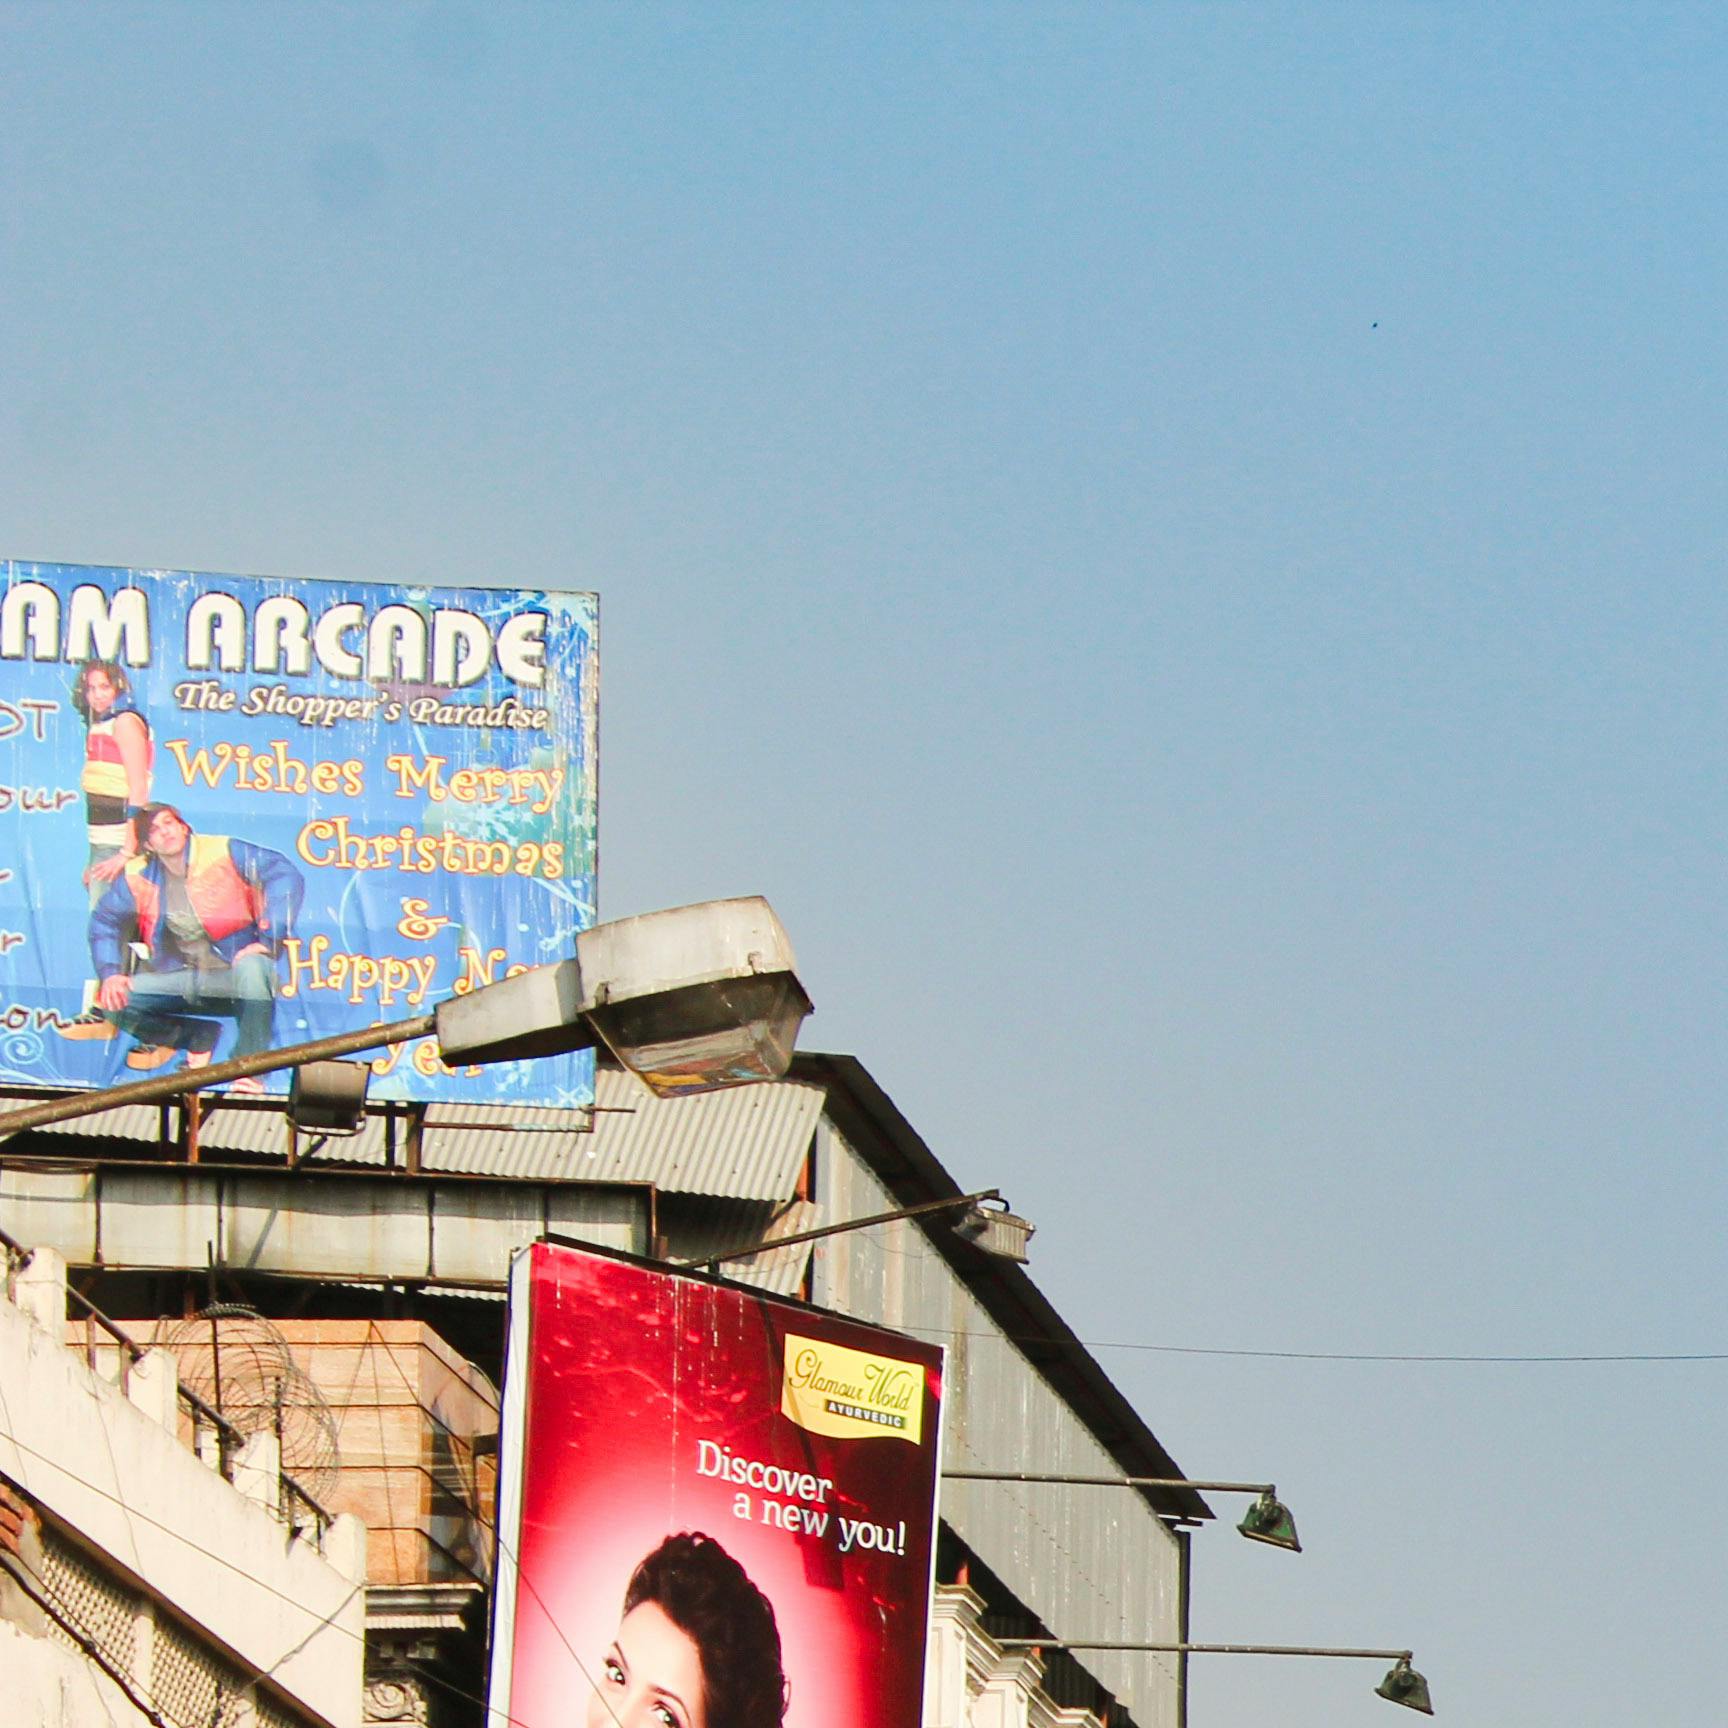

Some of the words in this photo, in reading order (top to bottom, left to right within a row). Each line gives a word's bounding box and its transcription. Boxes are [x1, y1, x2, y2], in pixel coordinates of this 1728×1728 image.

[187, 591, 549, 687] ARCADE
[174, 680, 235, 712] The
[241, 686, 402, 726] Shopper's
[409, 694, 549, 730] Paradise
[166, 739, 364, 796] Wishes
[387, 754, 564, 814] Merry
[298, 816, 564, 880] Christmas
[397, 897, 448, 941] &
[281, 936, 437, 1005] Happy
[788, 1348, 864, 1402] Glamour
[863, 1363, 915, 1411] World
[827, 1402, 902, 1428] AYURVEDIC
[696, 1439, 832, 1504] Discover
[733, 1492, 751, 1520] a
[762, 1498, 829, 1538] new
[838, 1516, 906, 1556] you!
